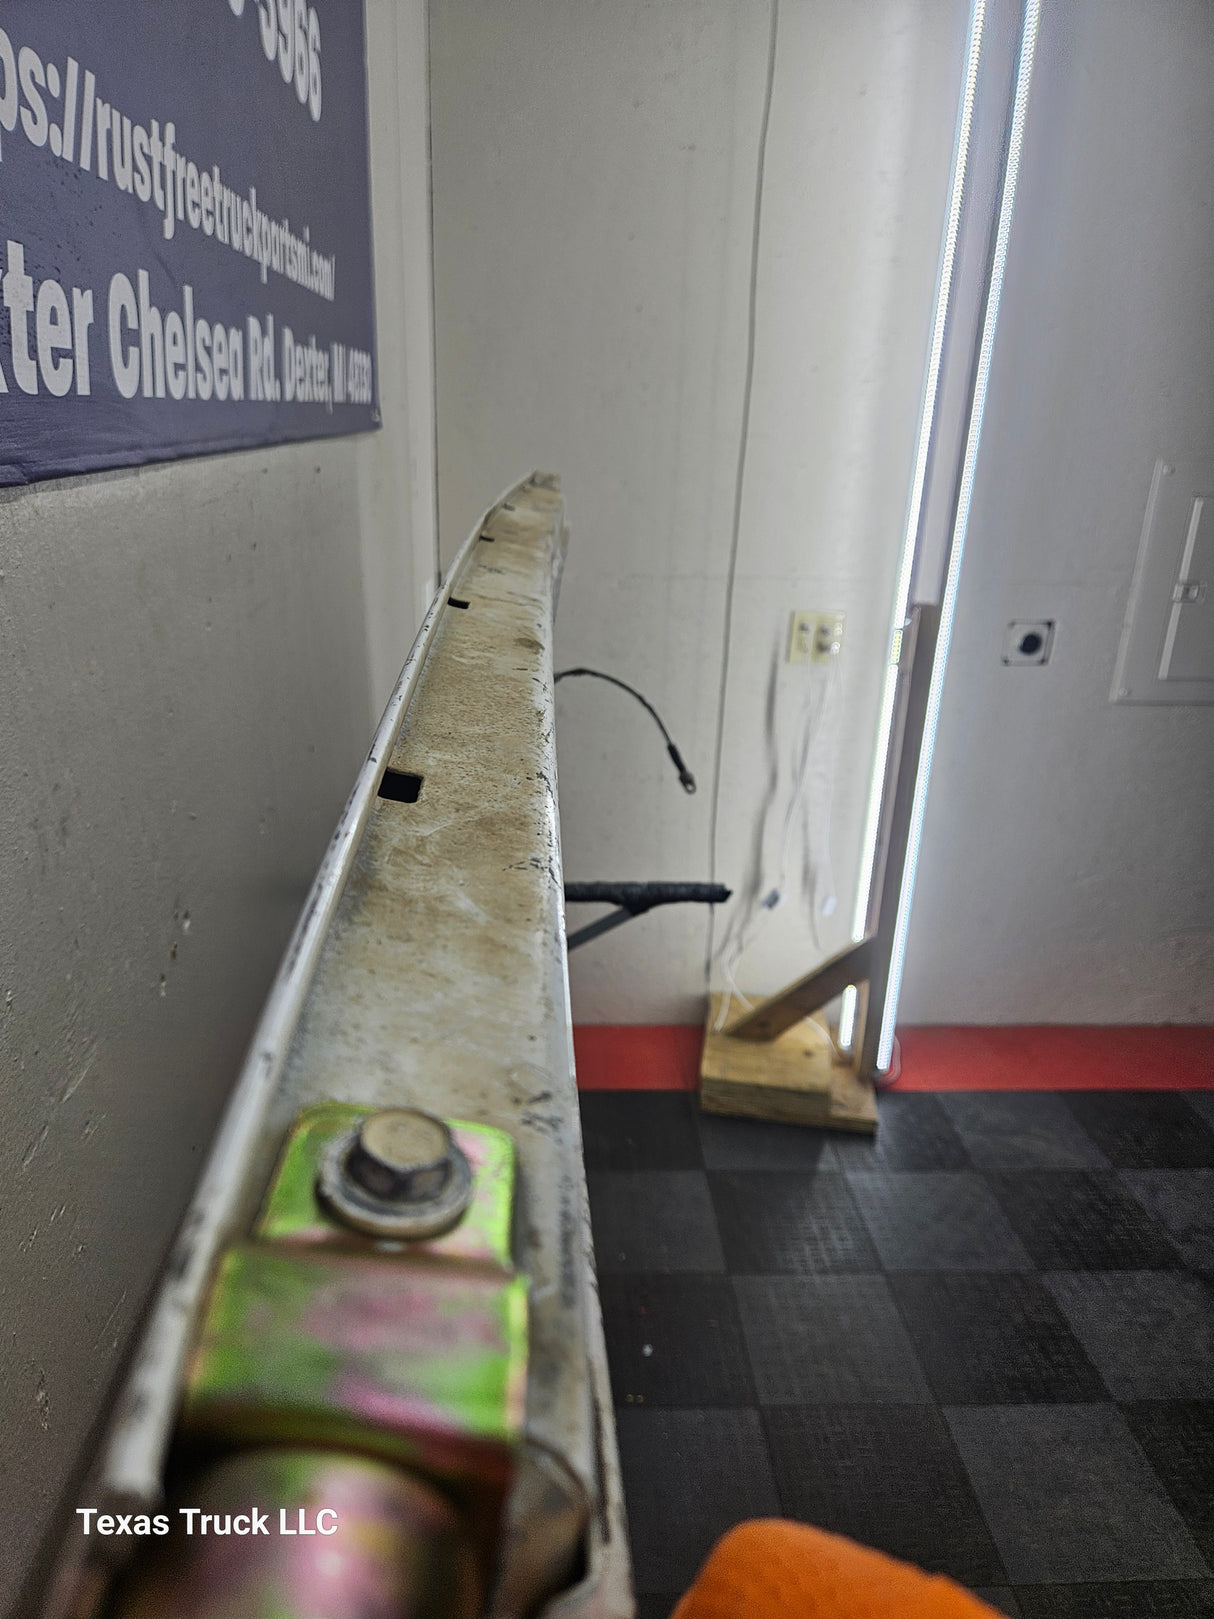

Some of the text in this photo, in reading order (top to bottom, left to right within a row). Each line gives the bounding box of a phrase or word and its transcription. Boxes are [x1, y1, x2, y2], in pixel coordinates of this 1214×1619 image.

[0, 239, 95, 397] ter
[108, 268, 244, 401] Chelsea
[247, 312, 281, 402] Rd.
